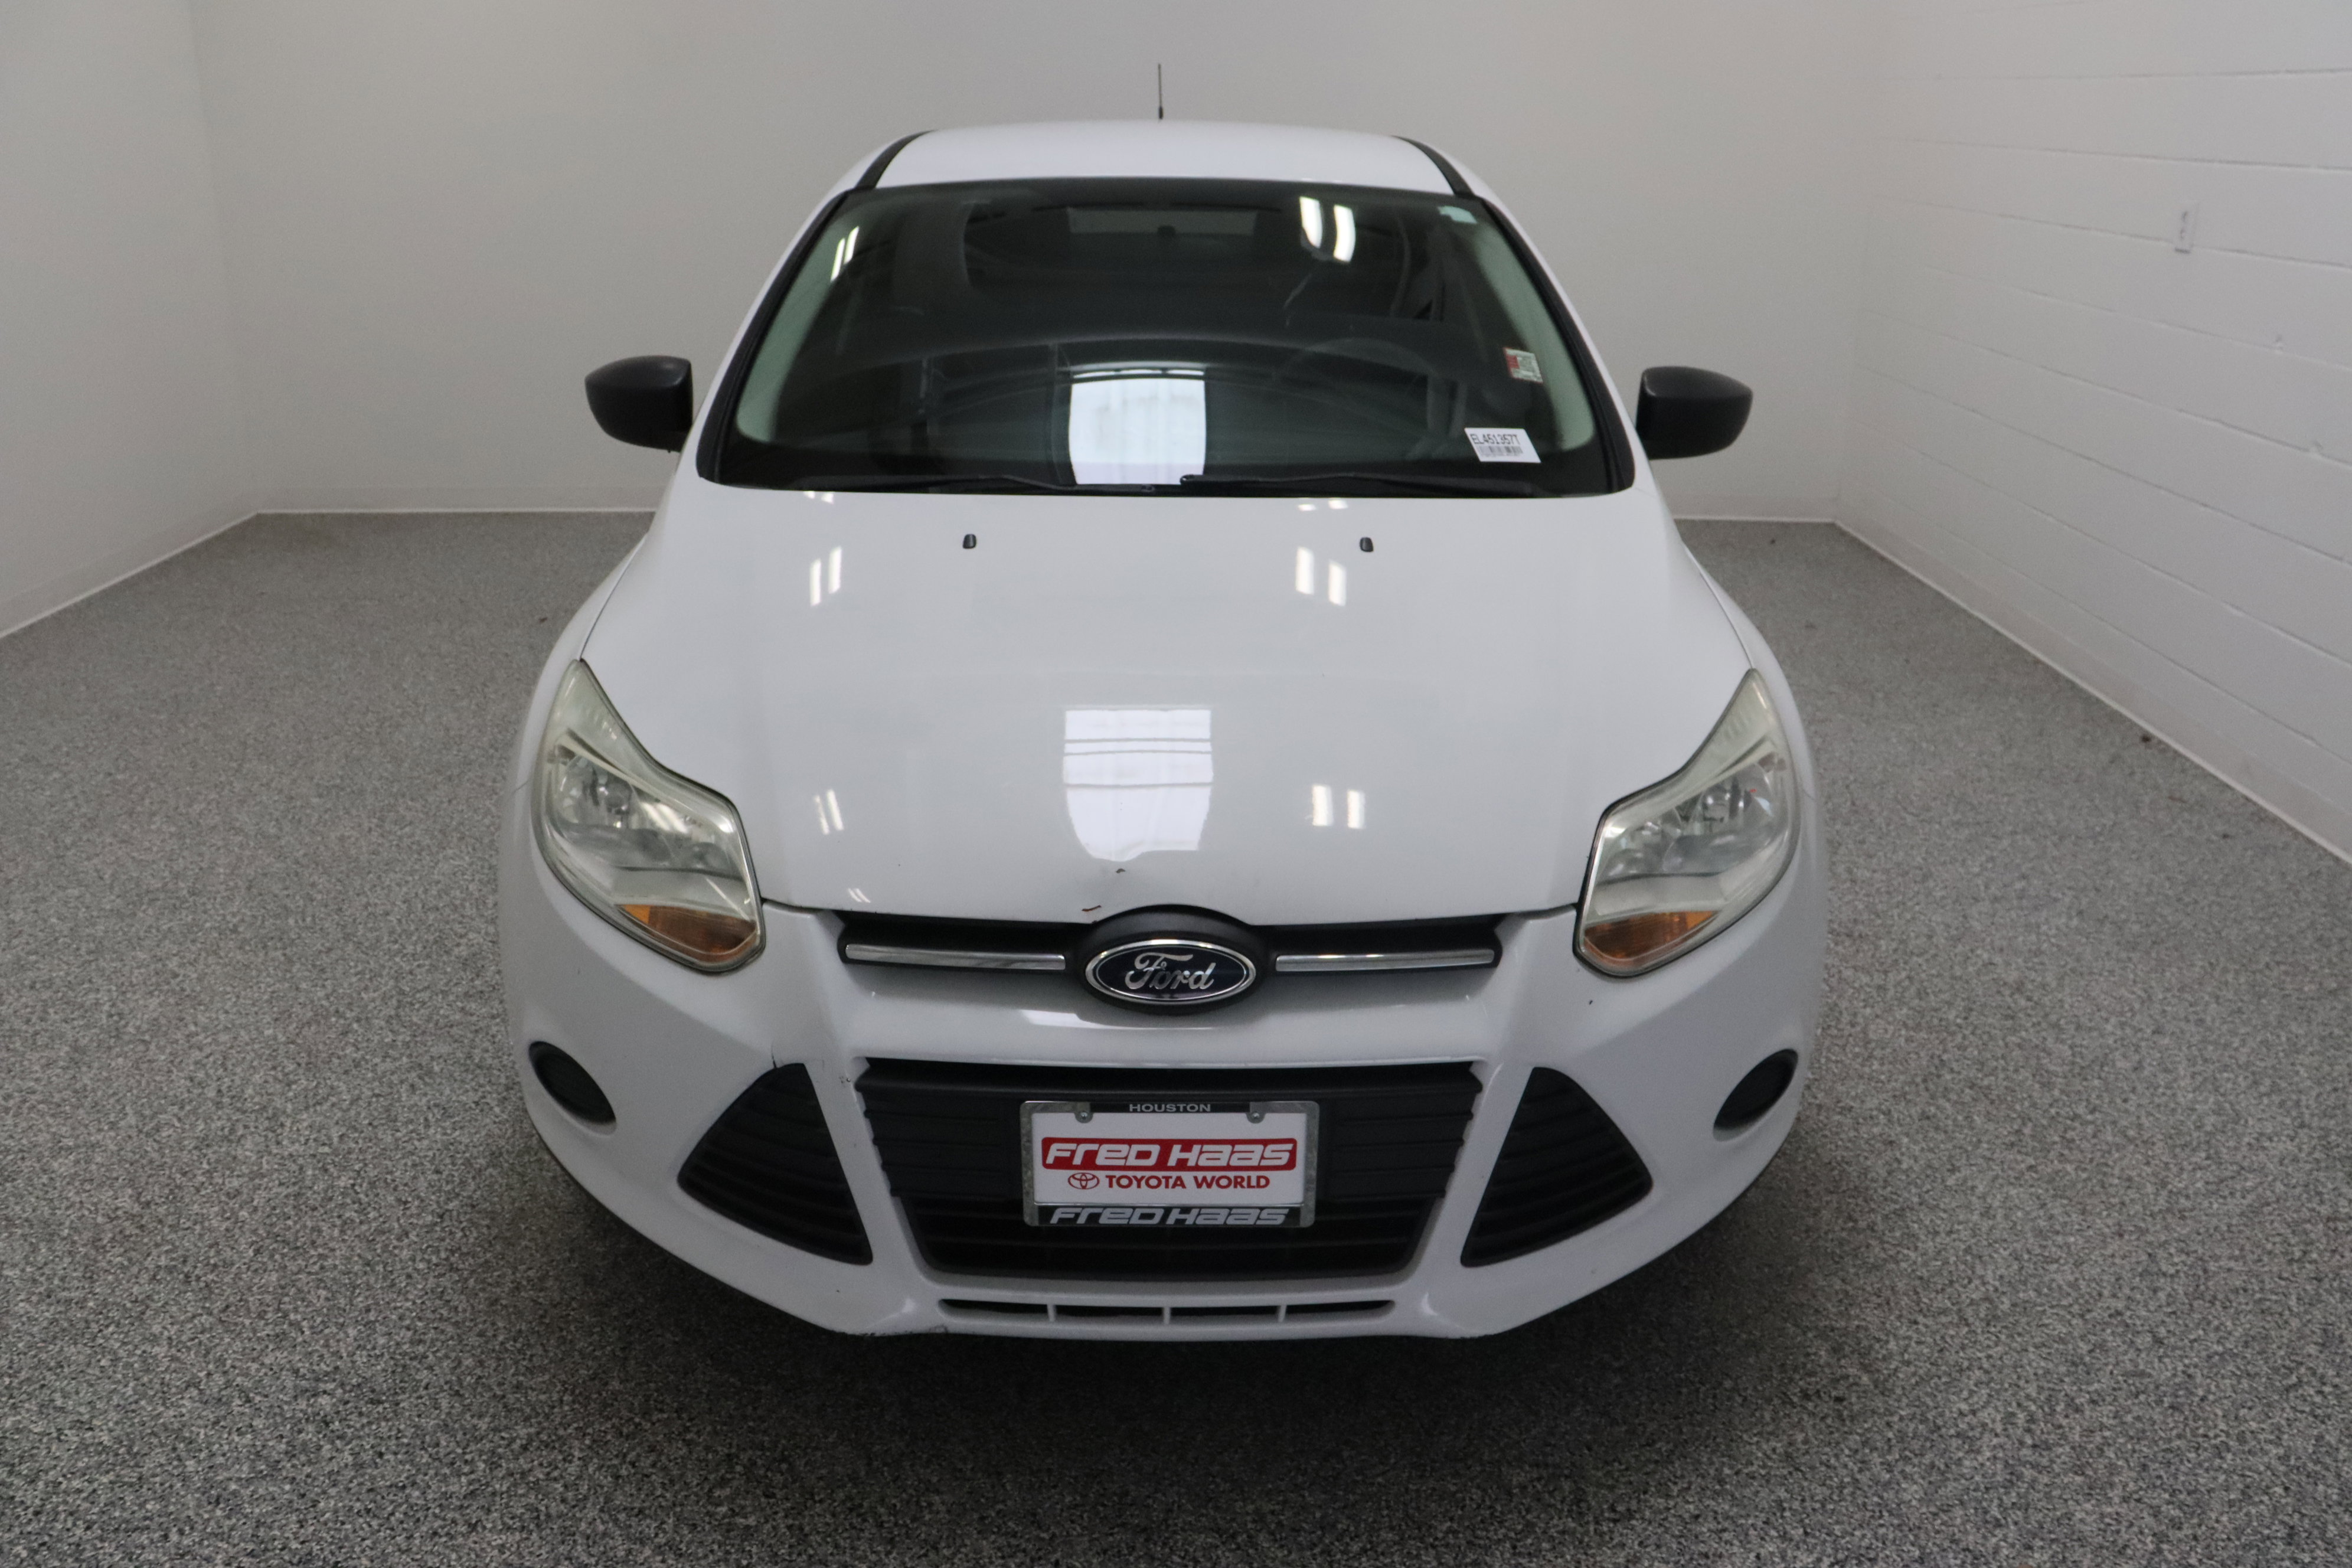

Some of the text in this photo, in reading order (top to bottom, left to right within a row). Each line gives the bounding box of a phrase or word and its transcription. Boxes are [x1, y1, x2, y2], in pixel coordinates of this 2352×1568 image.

[1125, 952, 1216, 989] Ford
[1129, 1103, 1211, 1112] HOUSTON
[1105, 1175, 1270, 1190] TOYOTA WORLD
